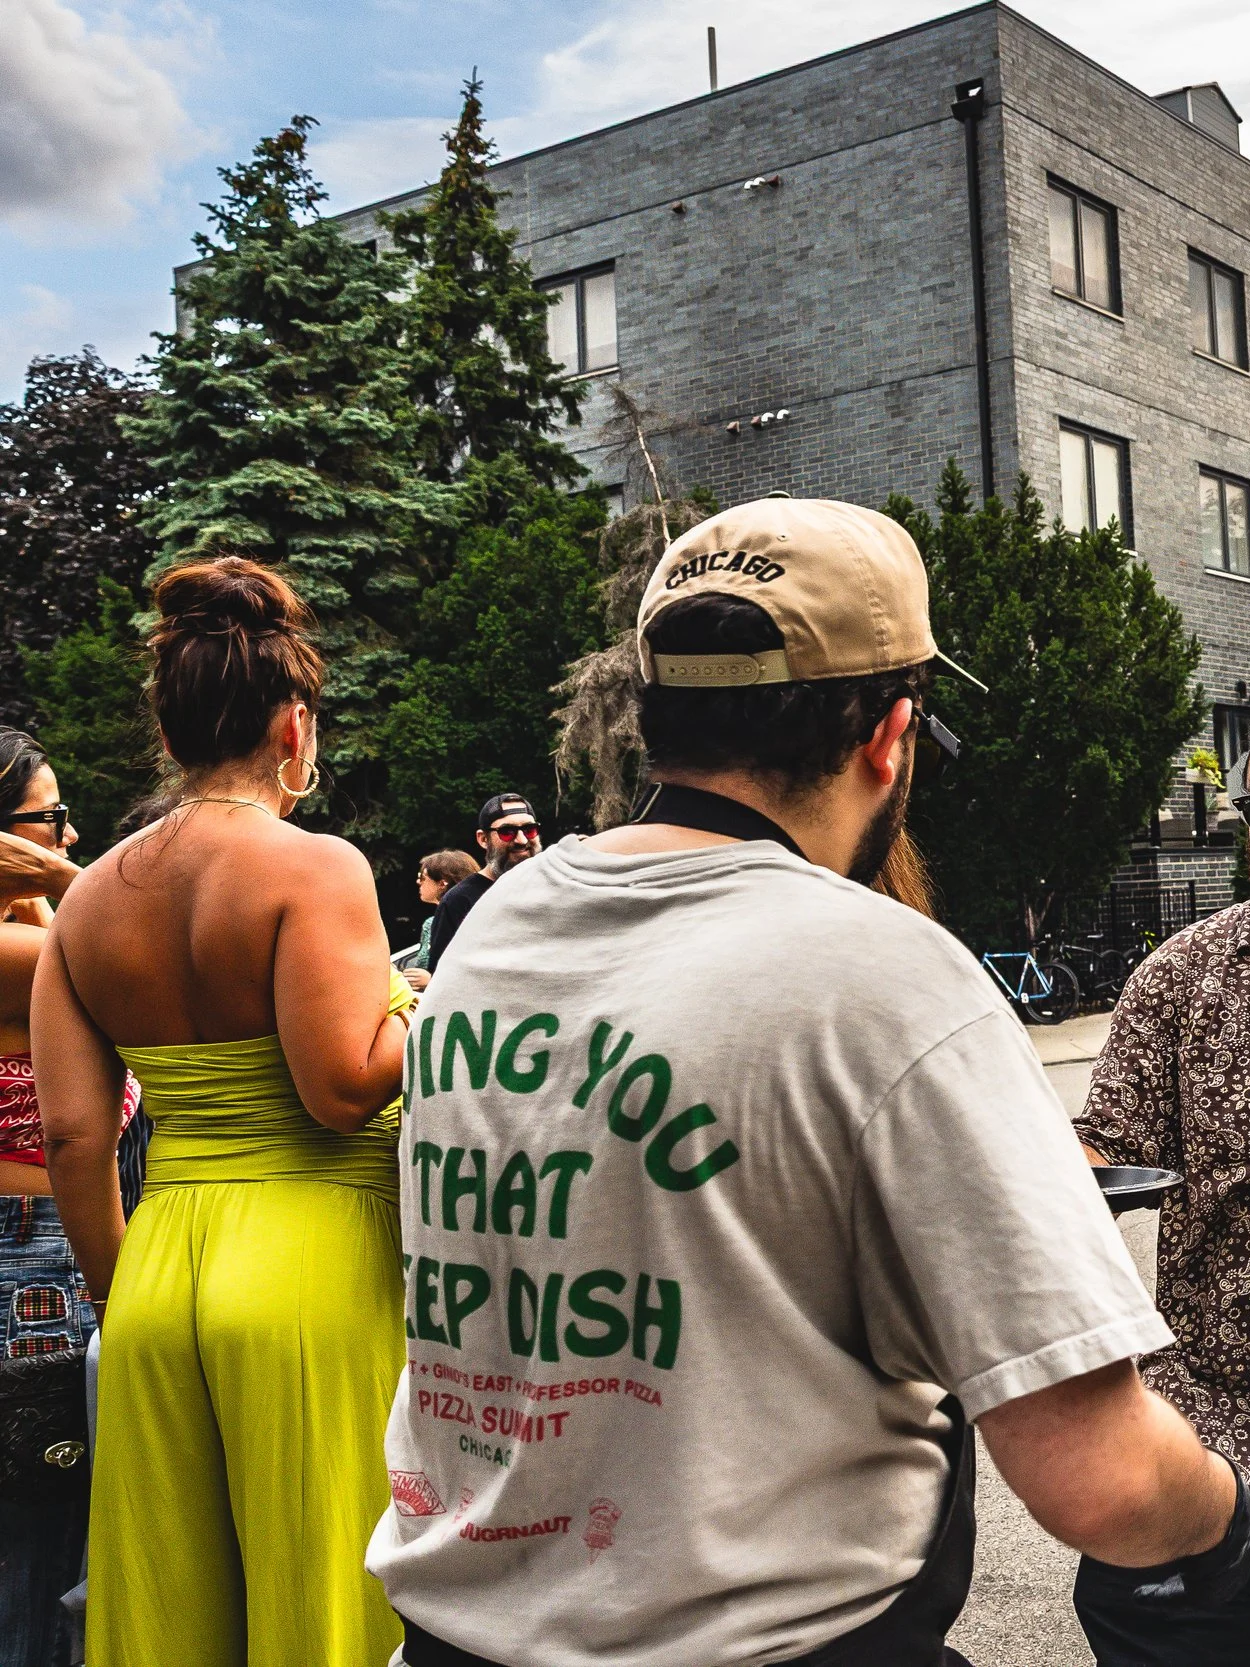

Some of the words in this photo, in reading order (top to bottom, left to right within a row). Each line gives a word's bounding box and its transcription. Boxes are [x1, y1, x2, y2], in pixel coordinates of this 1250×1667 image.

[665, 550, 786, 590] CHICAGO
[403, 1010, 560, 1114] ING
[572, 1021, 740, 1192] YOU
[412, 1141, 593, 1239] THAT
[507, 1267, 683, 1370] DISH
[417, 1389, 477, 1428] PIZZA
[473, 1374, 514, 1393] EAST
[624, 1378, 664, 1407] PIZZA
[459, 1515, 573, 1543] JUGRNAUT
